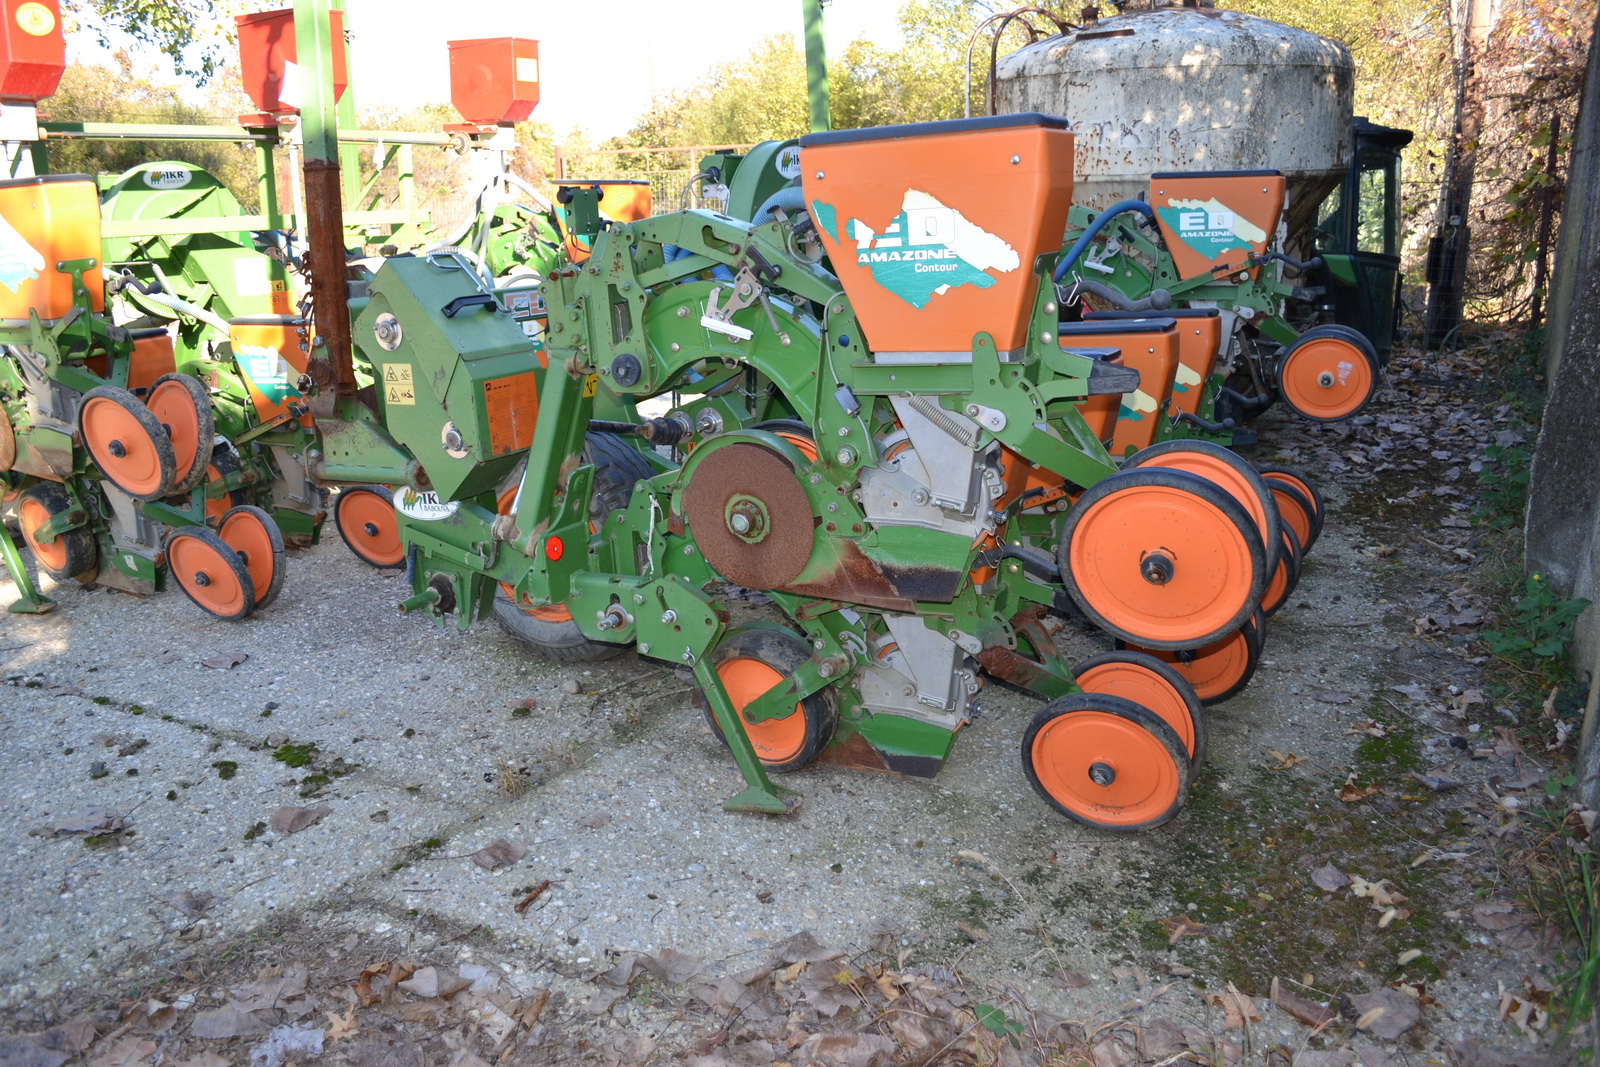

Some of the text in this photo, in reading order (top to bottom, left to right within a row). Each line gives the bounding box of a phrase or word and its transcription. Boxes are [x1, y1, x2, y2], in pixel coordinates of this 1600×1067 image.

[166, 171, 184, 180] IKR
[1180, 211, 1234, 231] ED
[858, 249, 957, 263] AMAZONE
[914, 263, 958, 273] Contour
[422, 493, 440, 505] IK
